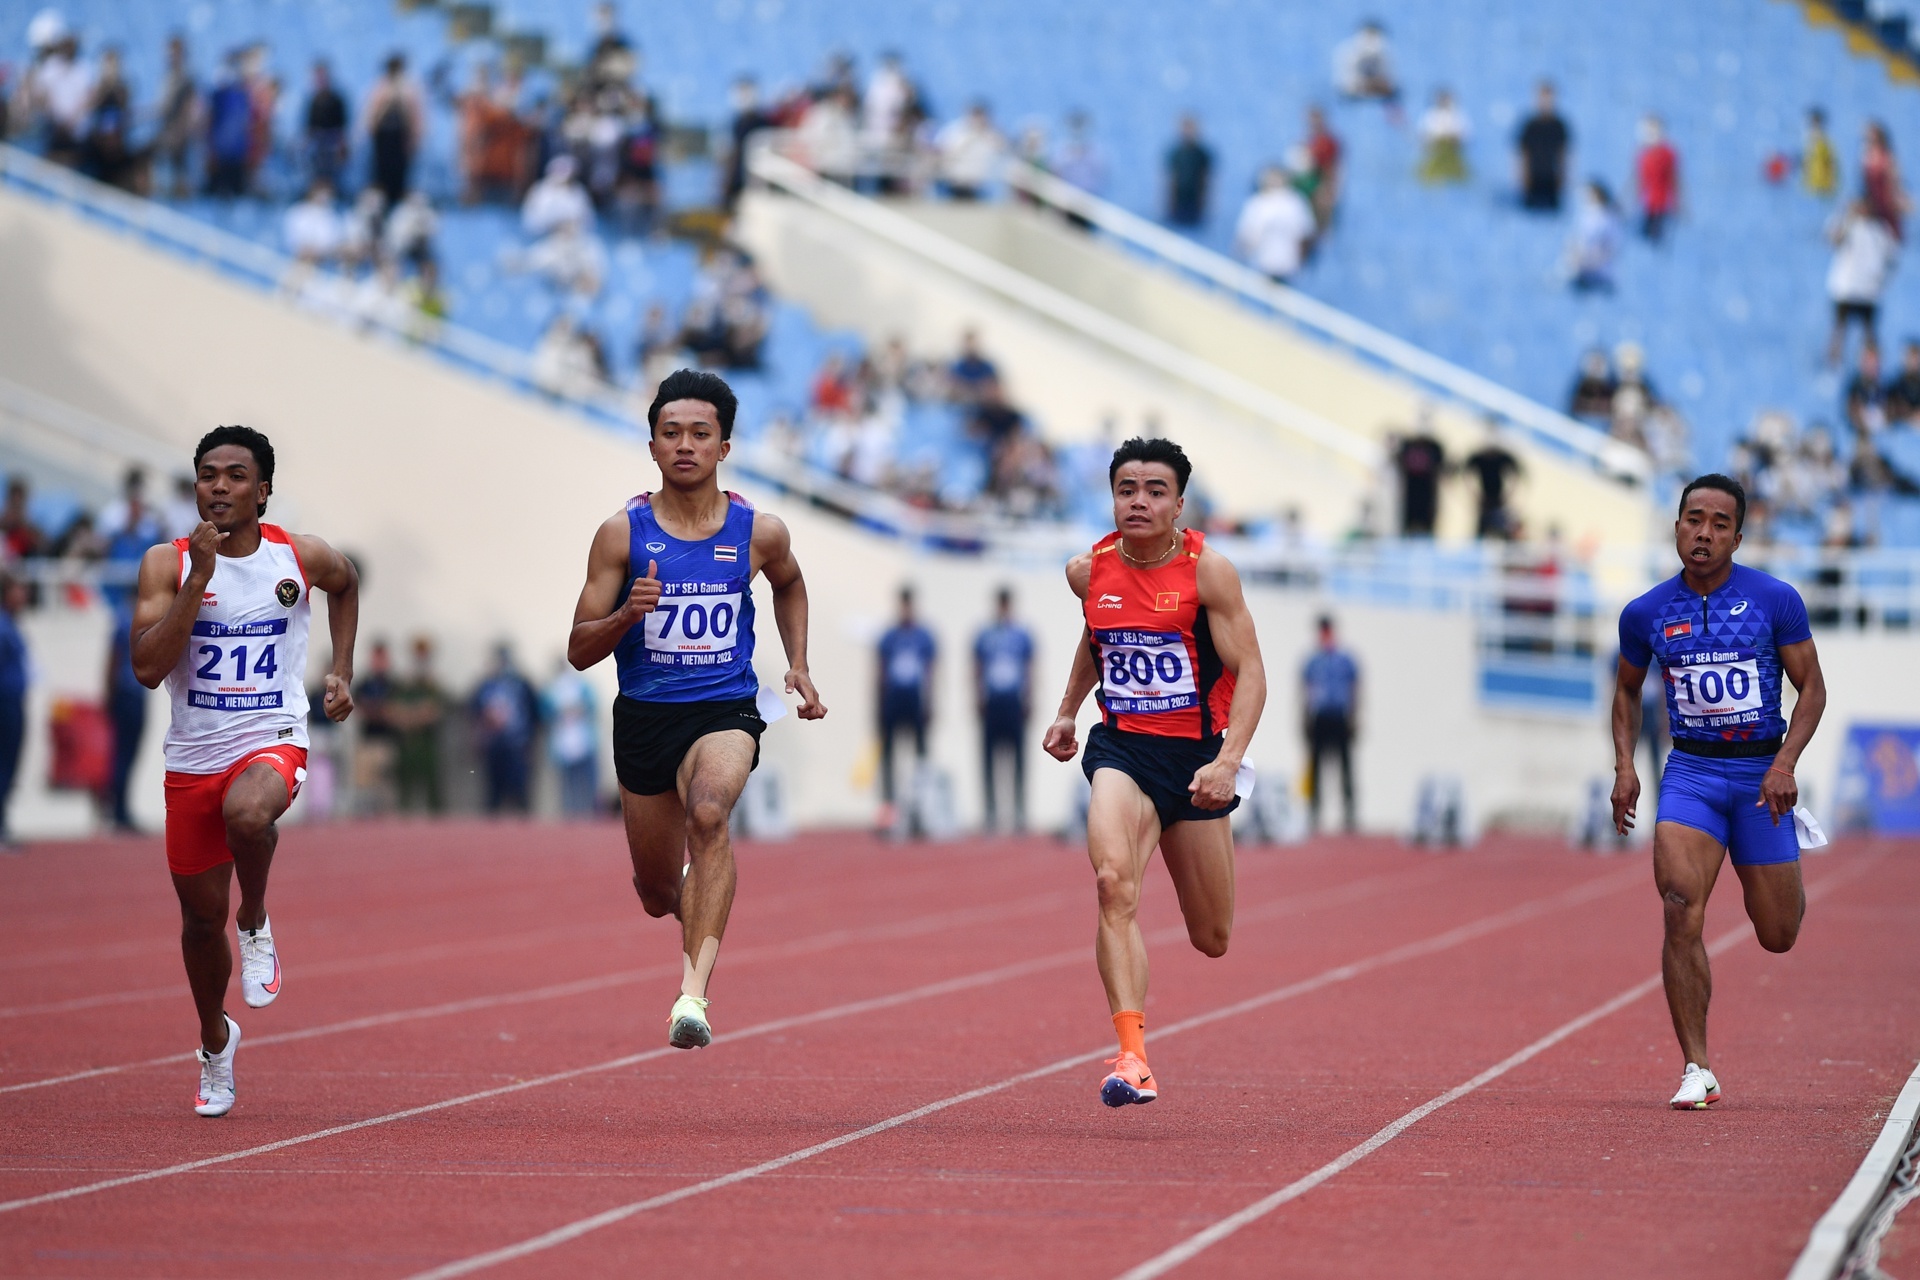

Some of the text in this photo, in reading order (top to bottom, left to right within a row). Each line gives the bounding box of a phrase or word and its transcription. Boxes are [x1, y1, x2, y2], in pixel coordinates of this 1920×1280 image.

[682, 583, 698, 594] SEA
[700, 582, 728, 593] Games
[654, 602, 734, 640] 700
[226, 625, 243, 635] SEA
[245, 624, 273, 634] Games
[1123, 632, 1137, 643] SEA
[1138, 633, 1164, 645] Games
[196, 643, 278, 681] 214
[650, 652, 675, 665] HANOI
[681, 654, 715, 665] VIETNAM
[716, 651, 733, 664] 2022
[1695, 652, 1711, 663] SEA
[1712, 651, 1739, 662] Games
[1107, 650, 1183, 686] 800
[1680, 667, 1750, 704] 100
[194, 693, 218, 707] HANOI
[225, 696, 259, 708] VIETNAM
[260, 694, 277, 706] 2022
[1137, 698, 1170, 711] VIETNAM
[1171, 696, 1190, 709] 2022
[1701, 706, 1735, 714] CAMBODIA
[1709, 714, 1741, 727] VIETNAM
[1742, 710, 1760, 723] 2022
[1734, 743, 1767, 754] NIKE
